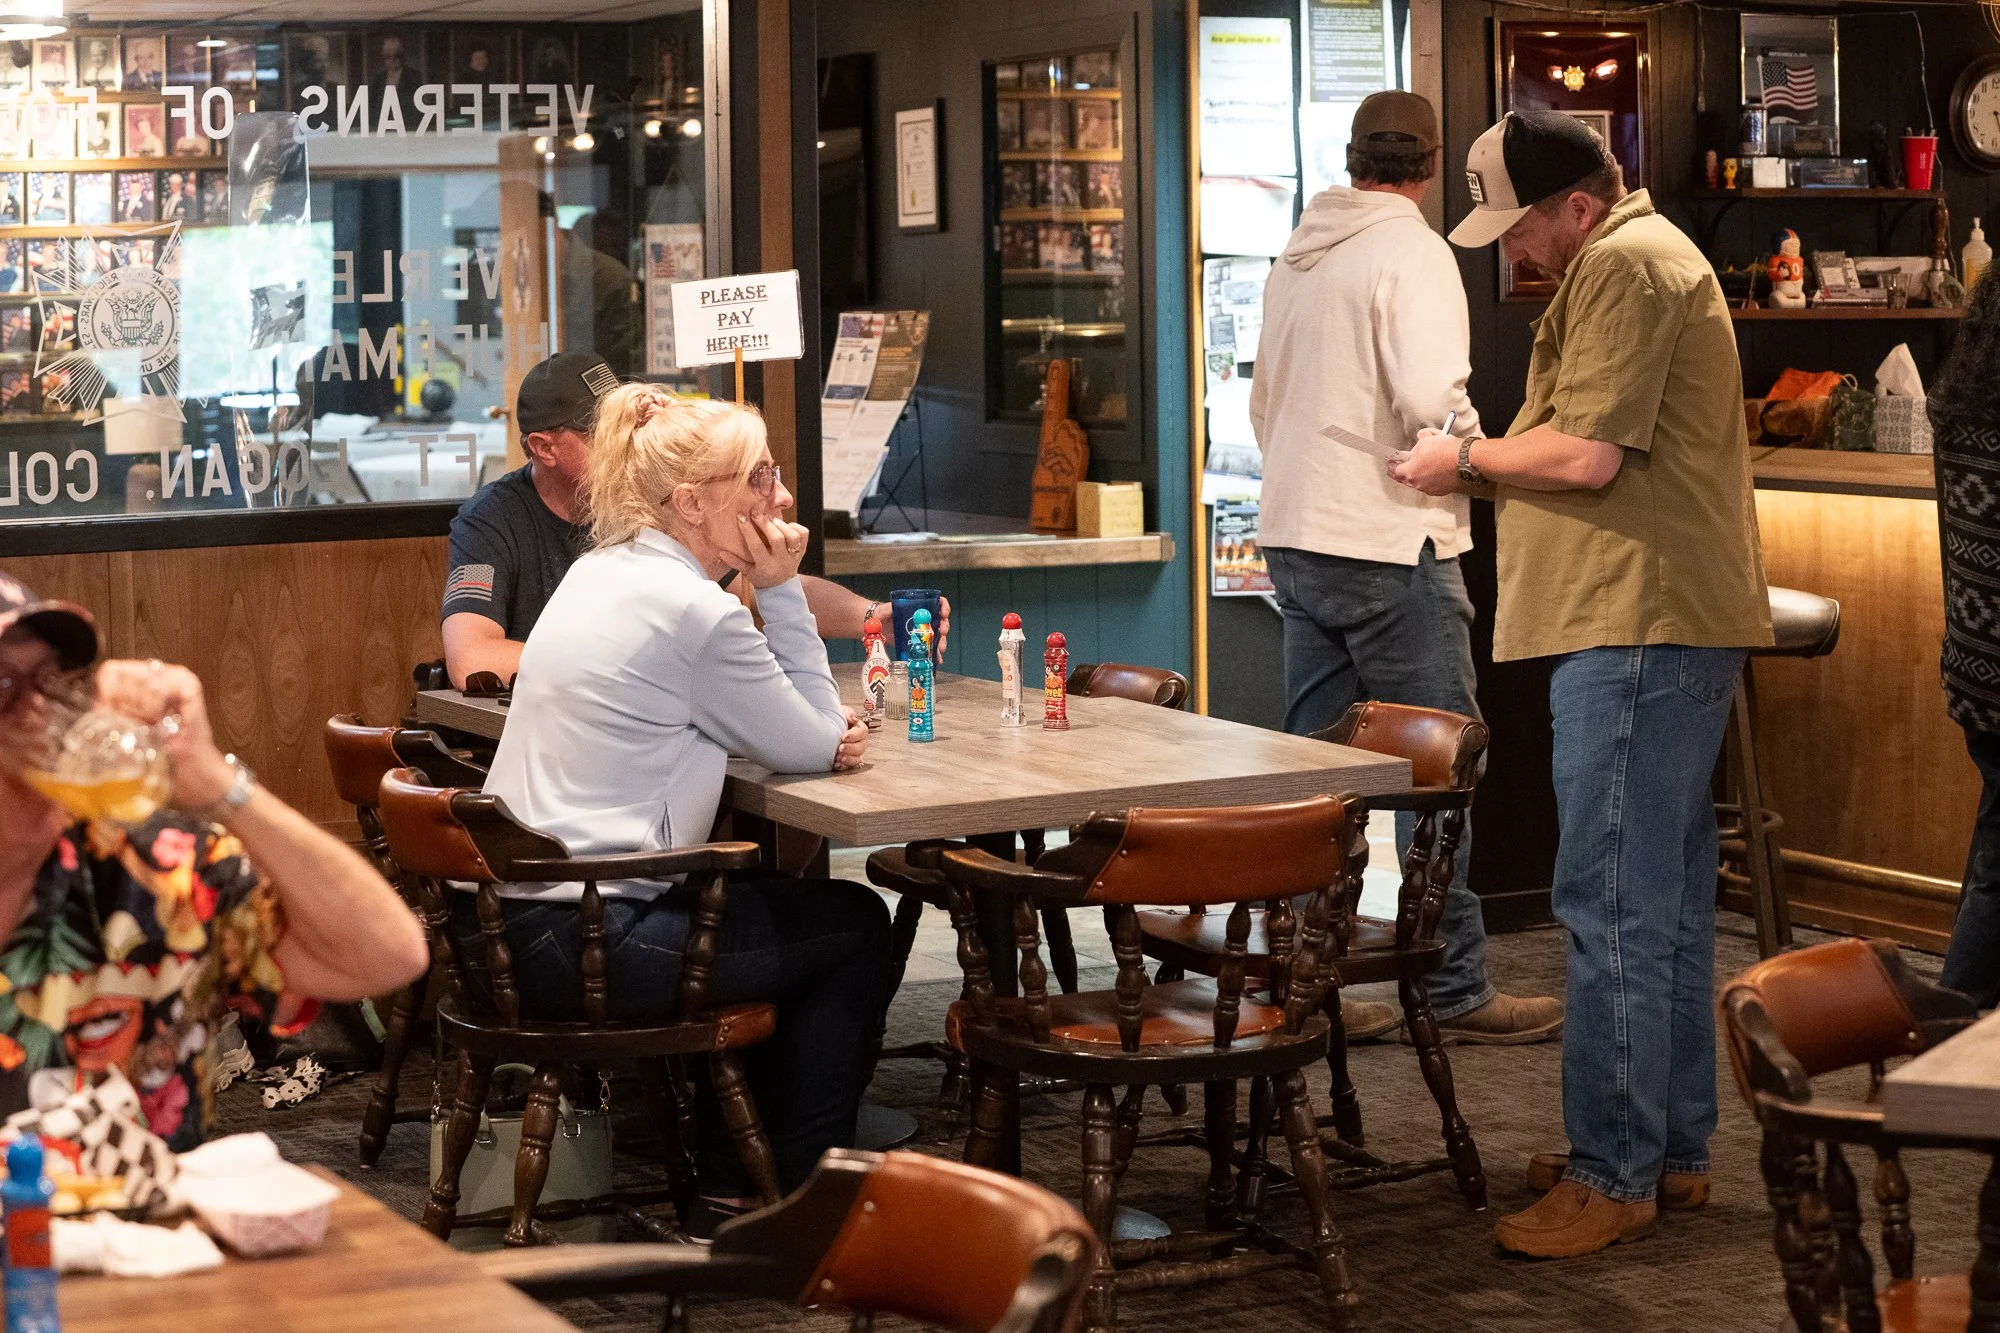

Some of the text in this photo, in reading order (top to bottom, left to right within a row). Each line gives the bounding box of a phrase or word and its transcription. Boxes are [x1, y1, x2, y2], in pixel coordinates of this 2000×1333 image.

[700, 284, 768, 305] PLEASE
[717, 306, 755, 327] PAY
[706, 334, 769, 352] HERE!!!
